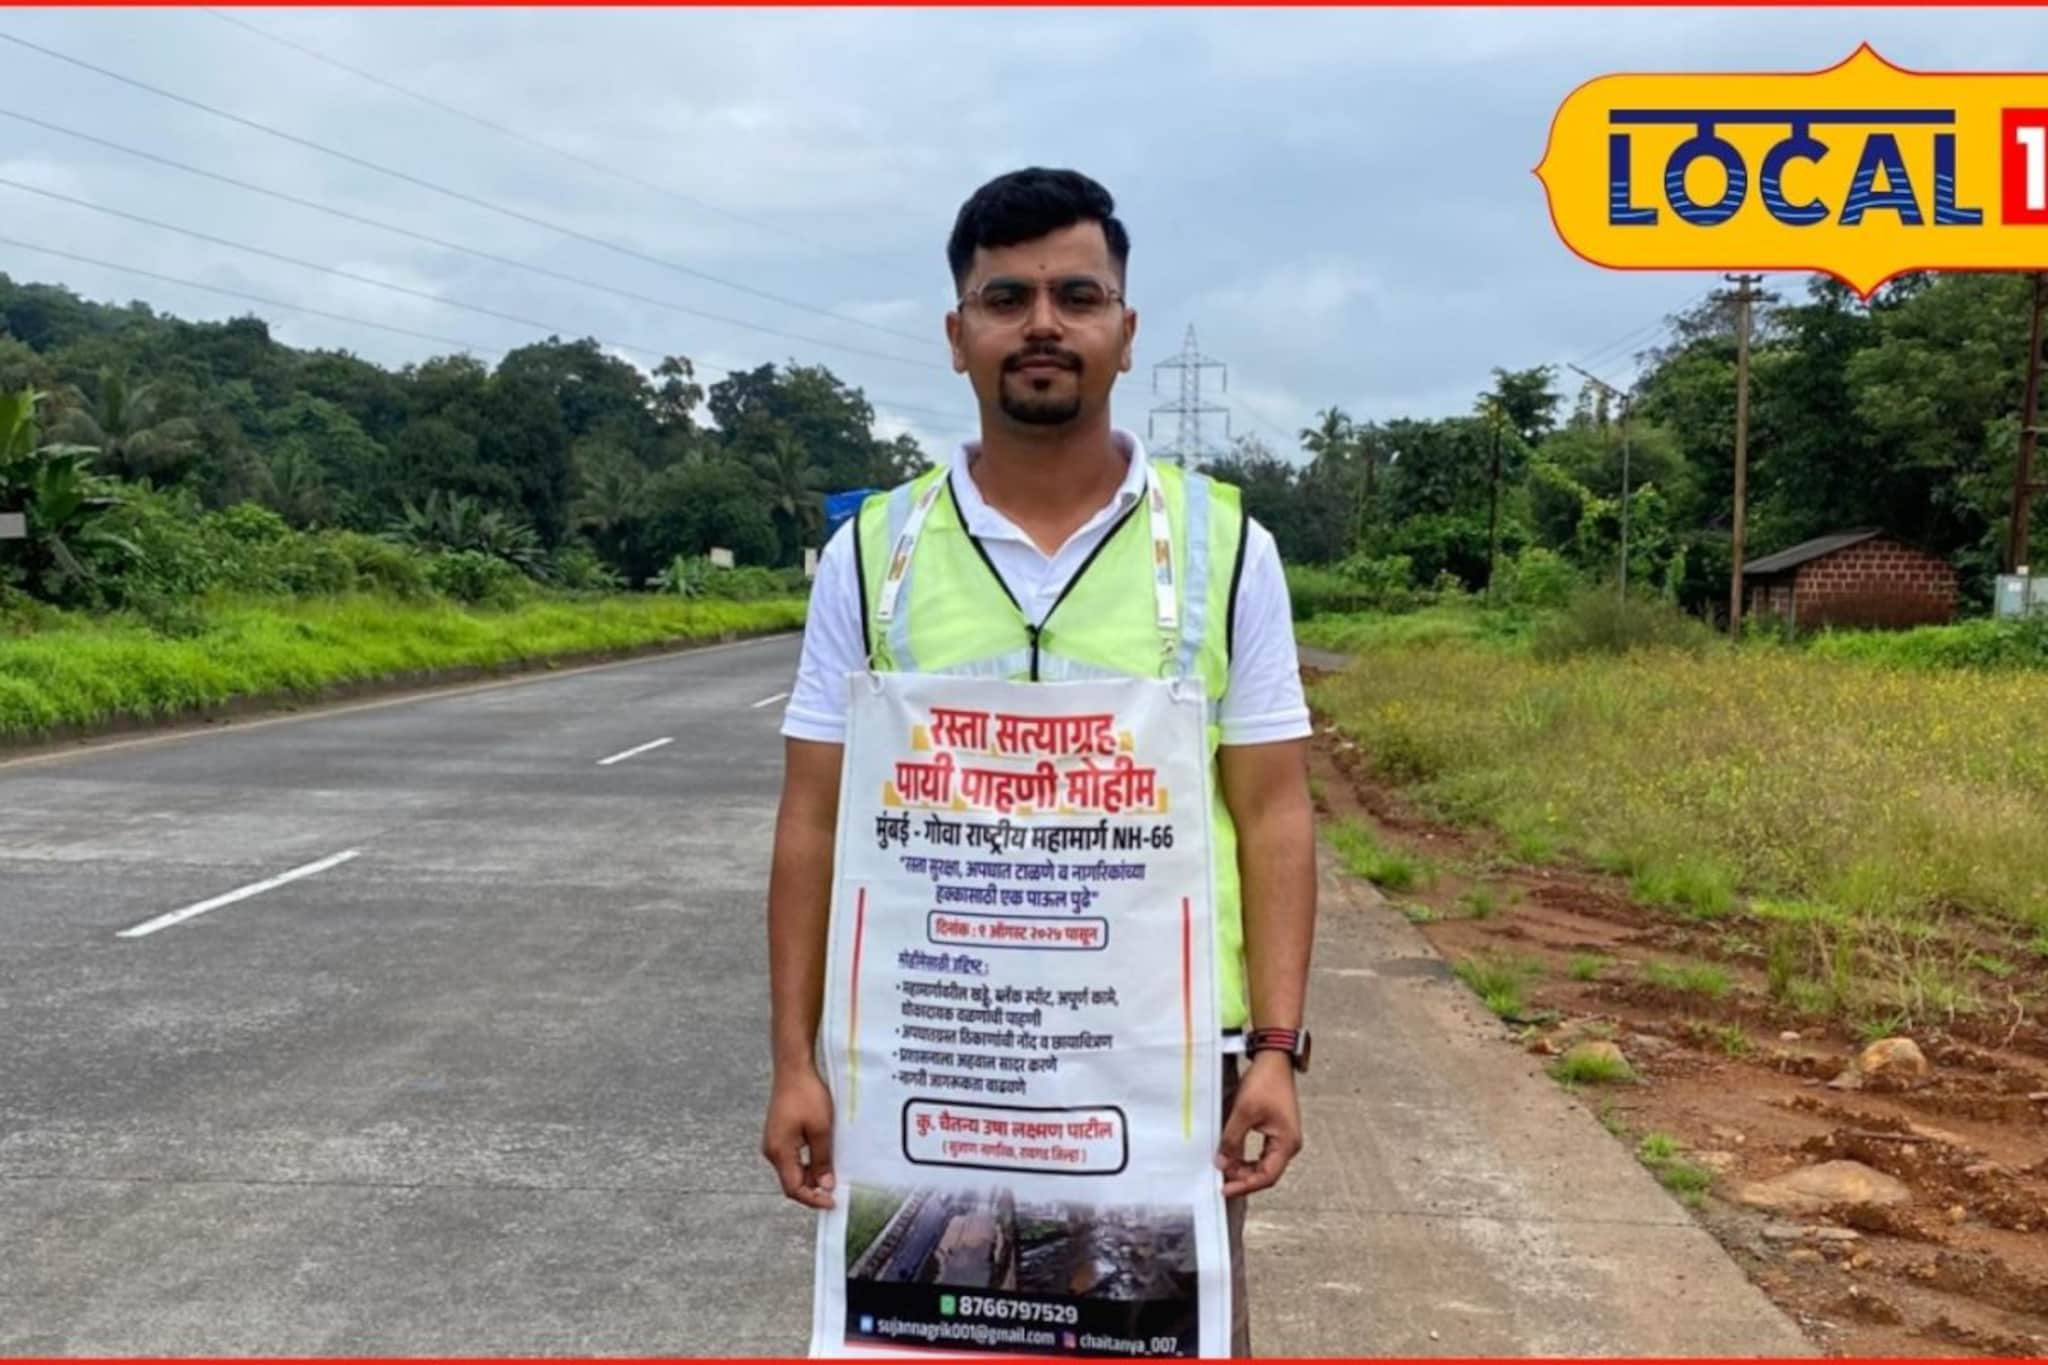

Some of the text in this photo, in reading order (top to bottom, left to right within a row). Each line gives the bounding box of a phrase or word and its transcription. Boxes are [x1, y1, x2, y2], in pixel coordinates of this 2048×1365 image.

[930, 708, 1115, 756] रस्ता सत्याग्रह
[896, 754, 1156, 812] पायी पाहणी मोहीम
[876, 810, 910, 849] मुंबई
[924, 814, 961, 848] गोवा
[966, 818, 1025, 854] राष्ट्रीय
[1031, 819, 1108, 852] महामार्ग
[1112, 826, 1173, 850] NH-66
[966, 860, 1011, 879] अपघात
[1015, 859, 1054, 880] टाळणे
[1059, 865, 1068, 880] व
[1072, 859, 1145, 880] नागरिकांच्या
[936, 882, 996, 905] हक्कासाठी
[1000, 888, 1023, 905] एक
[1027, 890, 1066, 908] पाऊल
[940, 1110, 978, 1133] चैतन्य
[983, 1119, 1008, 1136] उषा
[1067, 1118, 1113, 1139] पाटील
[959, 1296, 1078, 1324] 8766797529
[877, 1317, 1055, 1346] sujannagrik001@gmail.com
